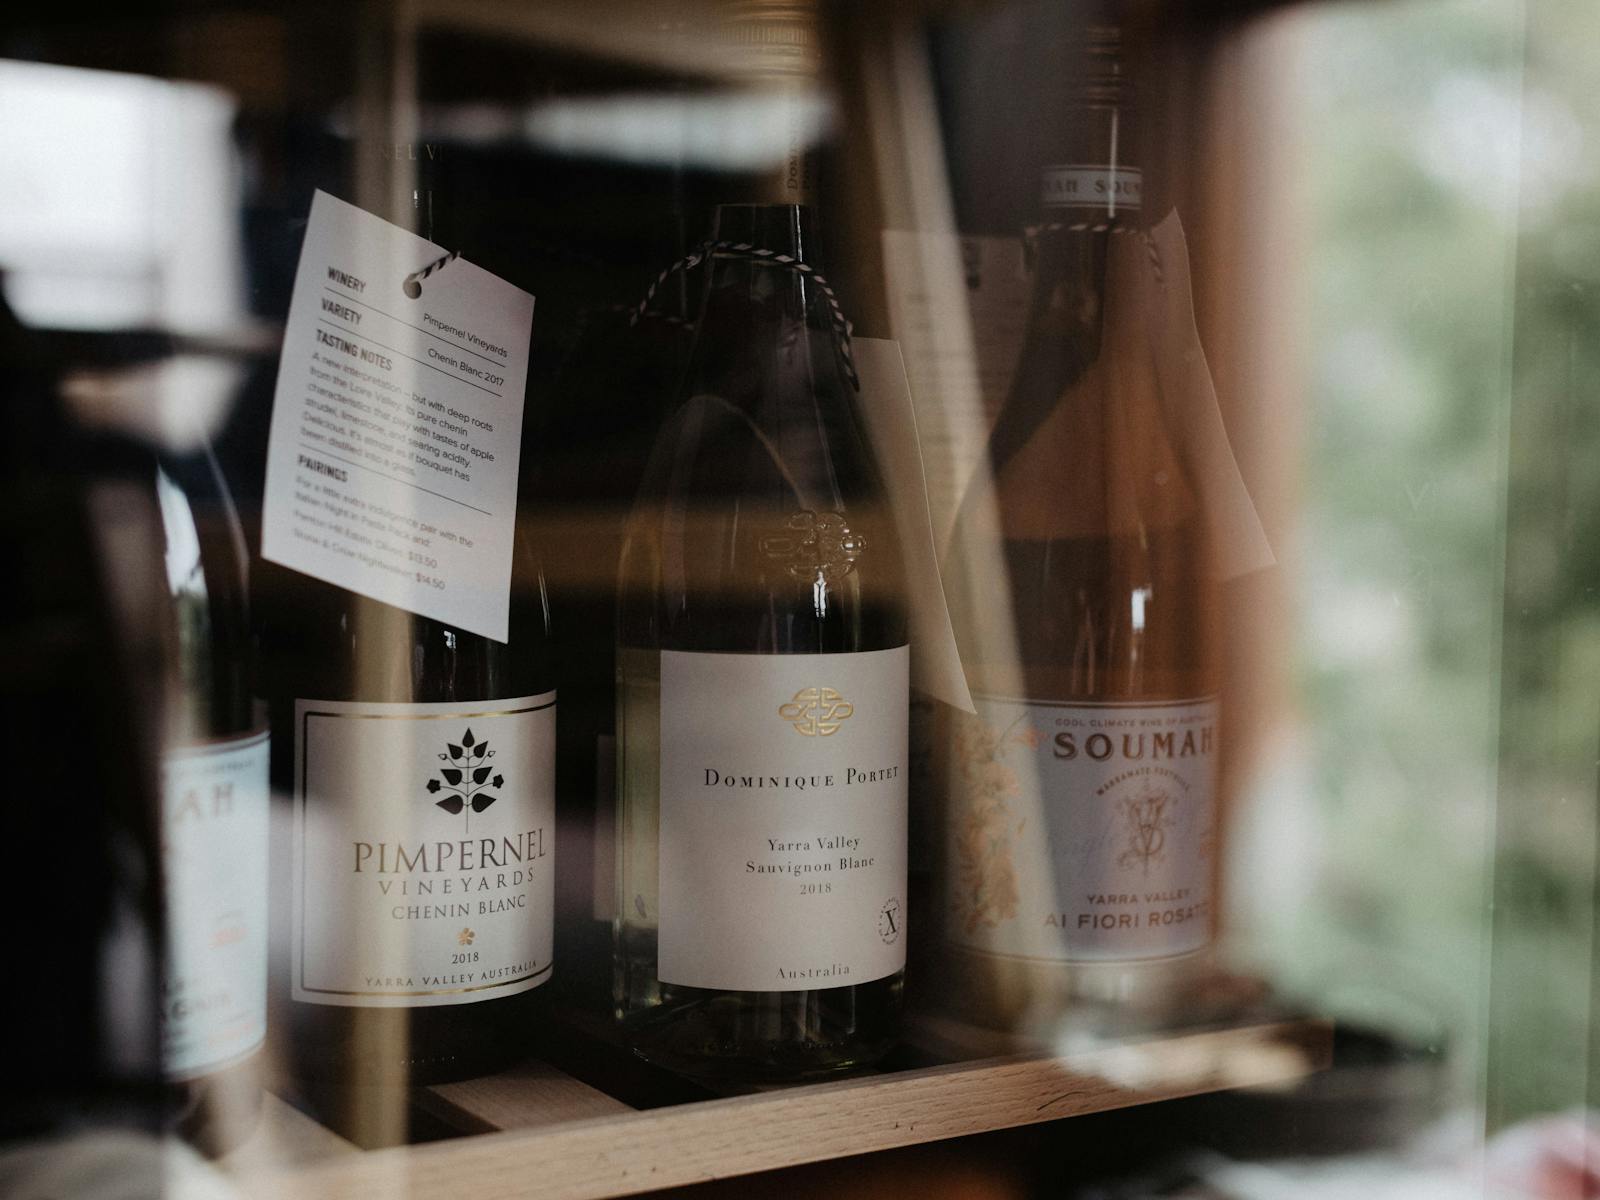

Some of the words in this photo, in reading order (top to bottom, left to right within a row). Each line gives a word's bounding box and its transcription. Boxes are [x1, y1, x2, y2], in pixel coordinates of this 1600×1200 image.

[328, 267, 366, 291] WINERY
[322, 298, 362, 324] VARIETY
[423, 312, 466, 339] Pimpernel
[467, 332, 508, 358] Vineyards
[317, 329, 358, 357] TASTING
[360, 348, 393, 371] NOTES
[427, 347, 458, 368] Chenin
[459, 361, 483, 379] Blanc
[484, 372, 505, 387] 2017
[412, 393, 427, 406] but
[428, 401, 446, 412] with
[447, 408, 470, 424] deep
[471, 418, 494, 432] roots
[416, 411, 438, 425] pure
[438, 420, 468, 437] chenin
[409, 438, 440, 458] searing
[413, 426, 431, 437] with
[432, 431, 458, 448] tastes
[459, 443, 470, 452] of
[470, 447, 495, 462] apple
[298, 454, 347, 482] PAIRINGS
[415, 454, 453, 475] bouquet
[454, 469, 470, 482] has
[419, 523, 438, 534] pair
[439, 531, 458, 542] with
[458, 536, 474, 548] the
[408, 551, 438, 569] $13.50
[415, 572, 446, 591] $14.50
[1089, 718, 1137, 728] CLIMATE
[1053, 726, 1213, 762] SOUMAH
[704, 768, 835, 790] DOMINIQUE
[847, 766, 899, 785] PORTET
[353, 828, 546, 873] PIMPERNEL
[768, 838, 811, 851] Yarra
[817, 836, 861, 851] Valley
[746, 860, 832, 876] Sauvignon
[839, 856, 875, 870] Blanc
[379, 867, 535, 896] VINEYARDS
[799, 882, 832, 895] 2018
[392, 903, 470, 920] CHENIN
[479, 894, 526, 914] BLANC
[1086, 893, 1138, 905] YARRA
[1145, 888, 1190, 903] VALLEY
[1078, 913, 1139, 929] FIORI
[452, 952, 480, 964] 2018
[365, 977, 414, 987] YARRA
[422, 973, 474, 986] VALLEY
[481, 959, 538, 980] AUSTRALIA
[776, 963, 851, 979] Australia
